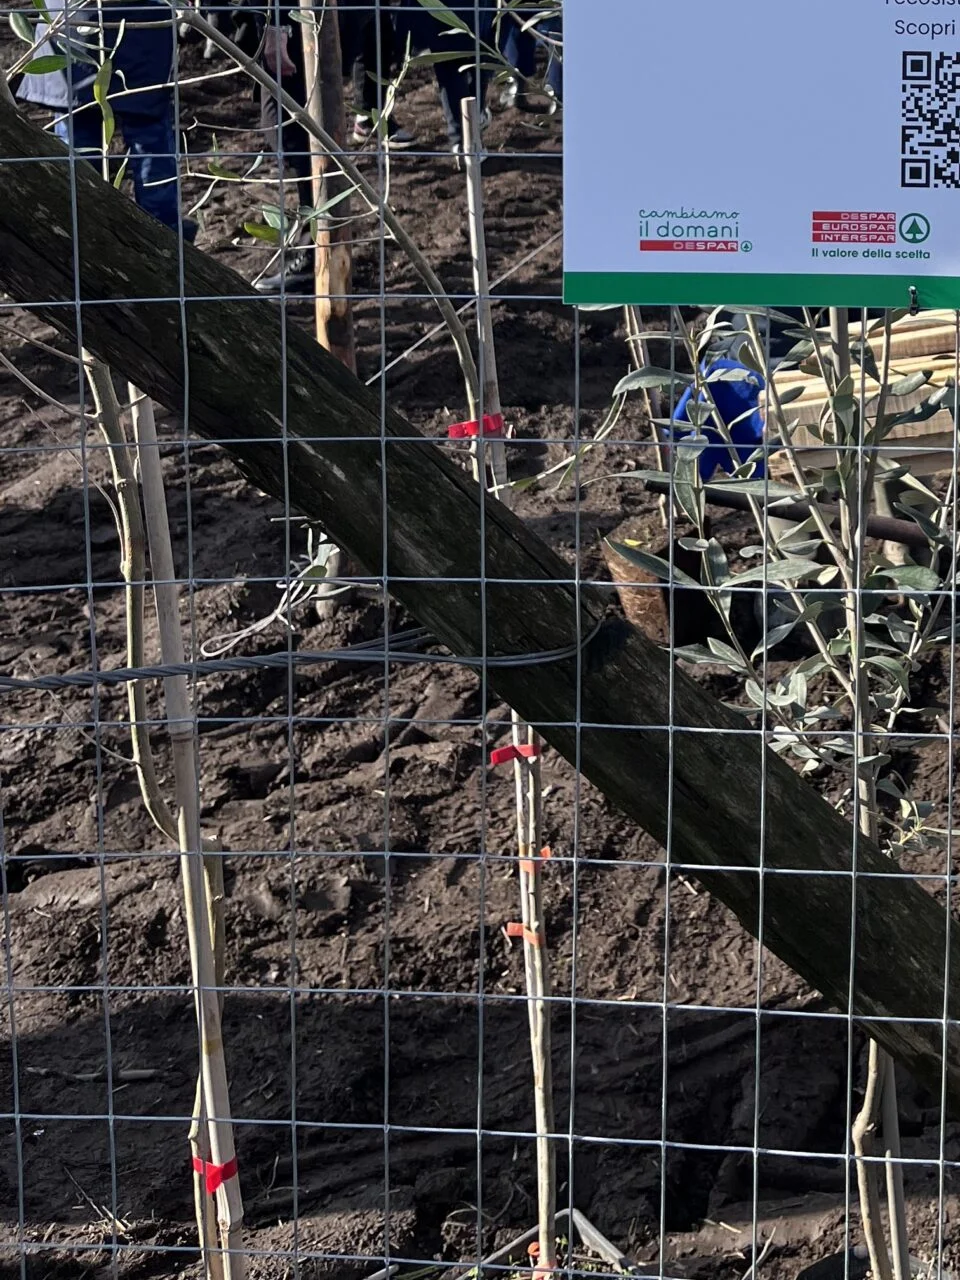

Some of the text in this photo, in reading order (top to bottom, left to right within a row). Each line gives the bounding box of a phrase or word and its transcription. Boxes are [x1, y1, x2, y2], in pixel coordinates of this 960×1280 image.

[894, 19, 956, 41] Scopri
[638, 206, 740, 219] cambiamo
[840, 212, 896, 221] DESPAR
[638, 220, 740, 238] il domani
[821, 222, 896, 232] EUROSPAR
[820, 233, 896, 242] INTERSPAR
[672, 241, 739, 251] DESPAR
[811, 247, 931, 260] Il valore della scelta
